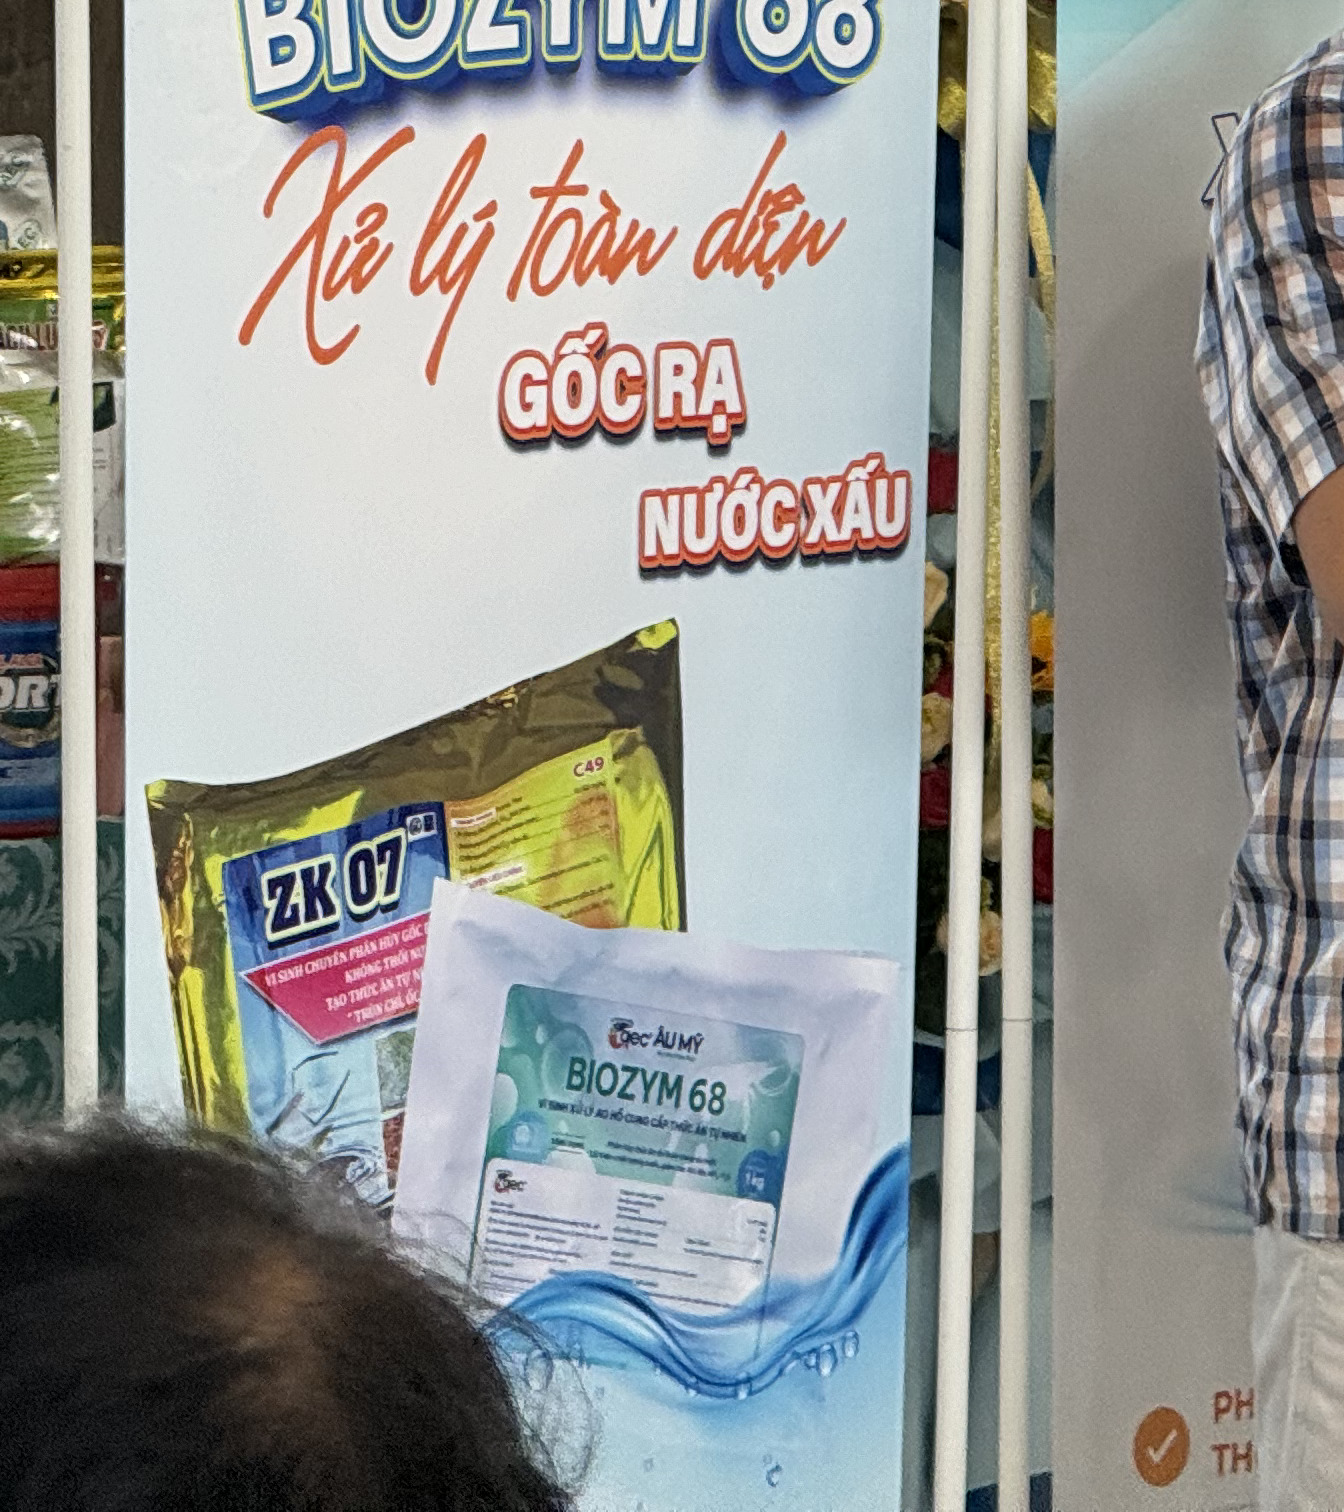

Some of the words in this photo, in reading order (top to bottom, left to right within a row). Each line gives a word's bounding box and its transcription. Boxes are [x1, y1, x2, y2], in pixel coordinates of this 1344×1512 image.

[238, 125, 415, 366] Xử
[408, 133, 498, 386] lý
[506, 138, 679, 302] toàn
[693, 130, 847, 291] diện
[499, 322, 647, 443] GỐC
[654, 338, 746, 450] RẠ
[638, 466, 800, 574] NƯỚC
[800, 453, 912, 559] XẤU
[573, 756, 605, 778] C49
[261, 854, 342, 950] ZK
[343, 828, 407, 921] 07
[564, 1055, 683, 1110] BIOZYM
[687, 1077, 727, 1116] 68
[653, 1024, 678, 1050] ÂU
[678, 1031, 705, 1055] MỸ
